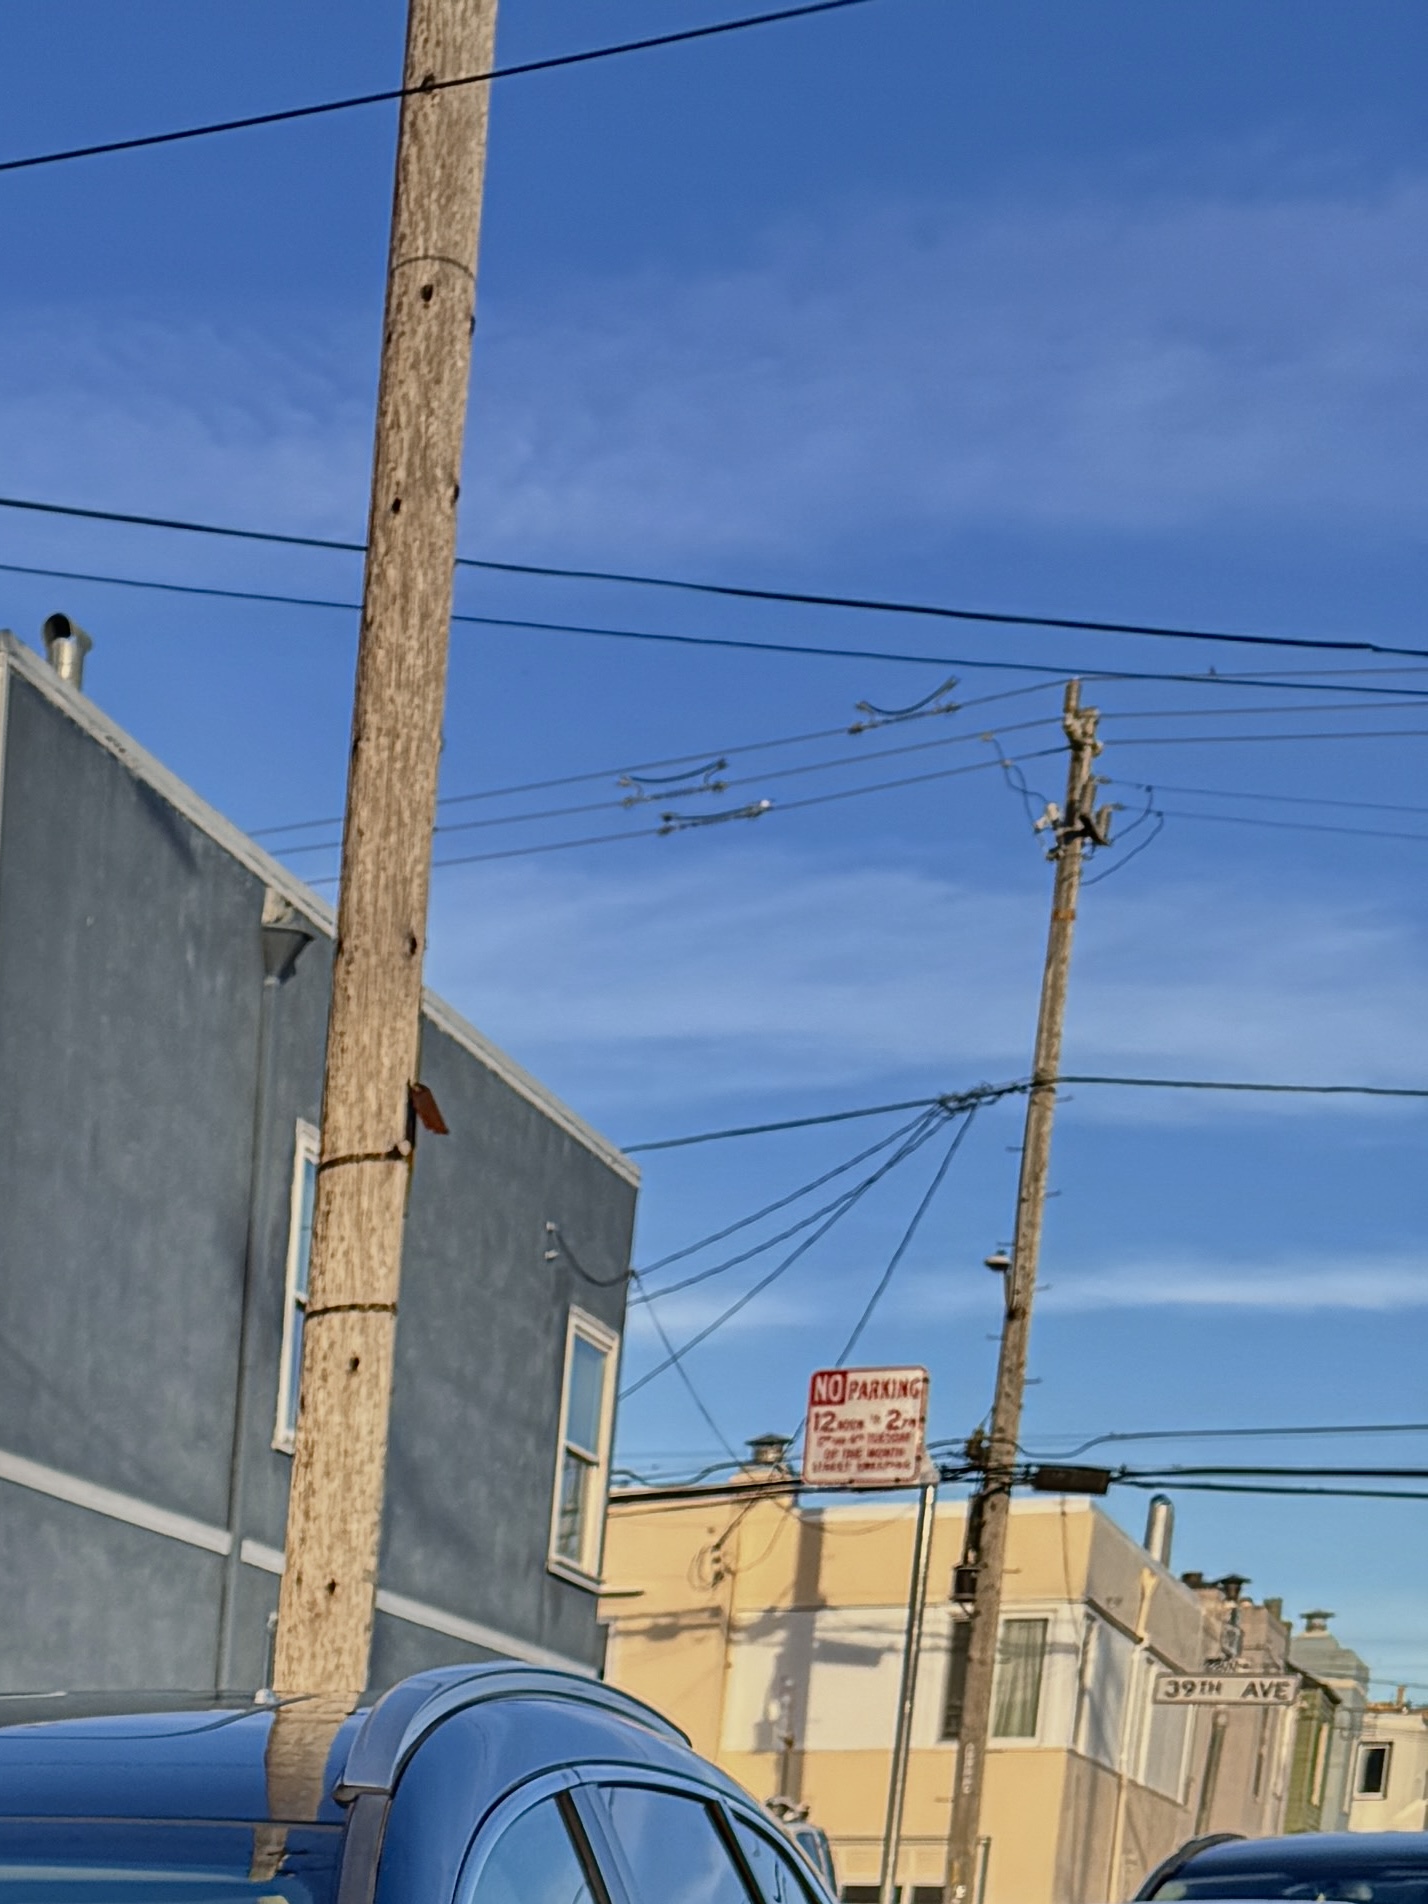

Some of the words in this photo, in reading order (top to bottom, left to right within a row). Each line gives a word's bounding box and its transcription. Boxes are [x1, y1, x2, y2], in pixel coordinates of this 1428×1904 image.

[815, 1374, 842, 1402] NO
[849, 1378, 920, 1400] PARKING
[1164, 1679, 1221, 1699] 39TH
[1240, 1680, 1290, 1699] AVE
